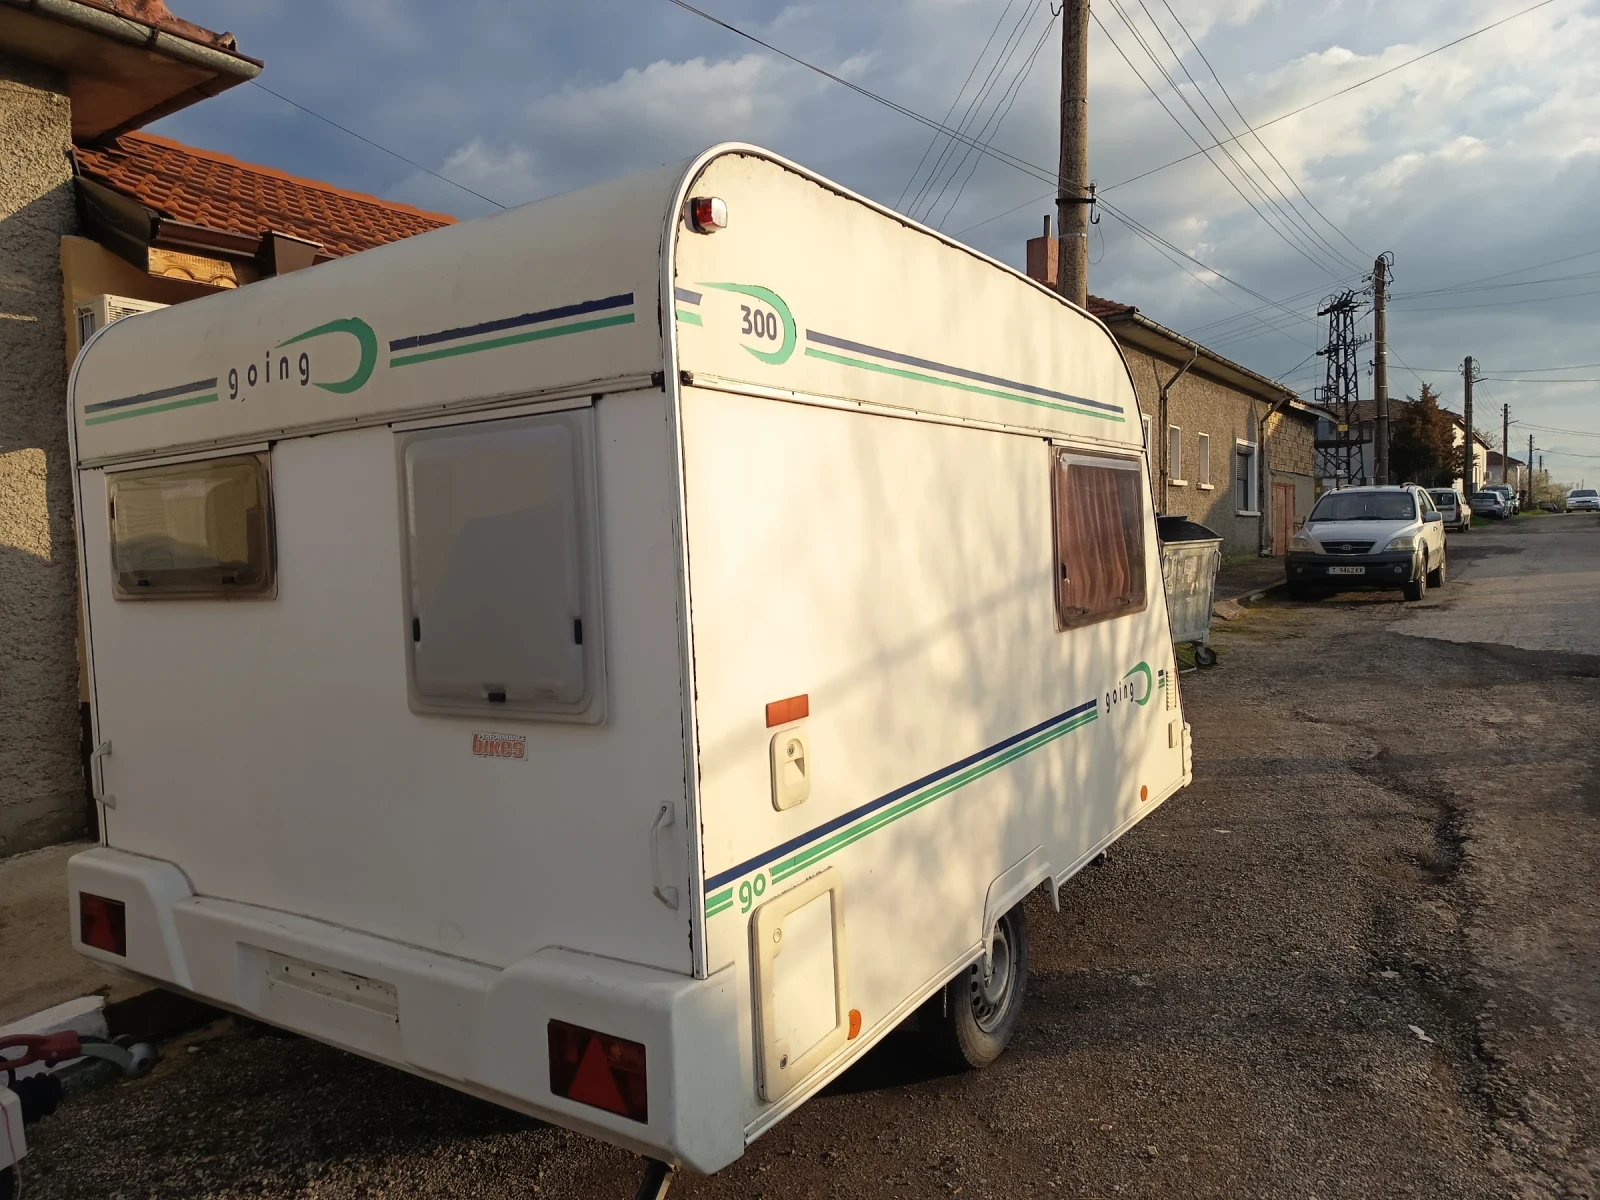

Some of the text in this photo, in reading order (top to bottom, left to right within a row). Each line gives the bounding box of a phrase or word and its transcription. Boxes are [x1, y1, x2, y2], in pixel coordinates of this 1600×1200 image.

[740, 304, 778, 341] 300
[228, 350, 310, 400] going
[1105, 680, 1134, 714] going
[472, 733, 525, 758] bikes
[738, 873, 767, 914] go
